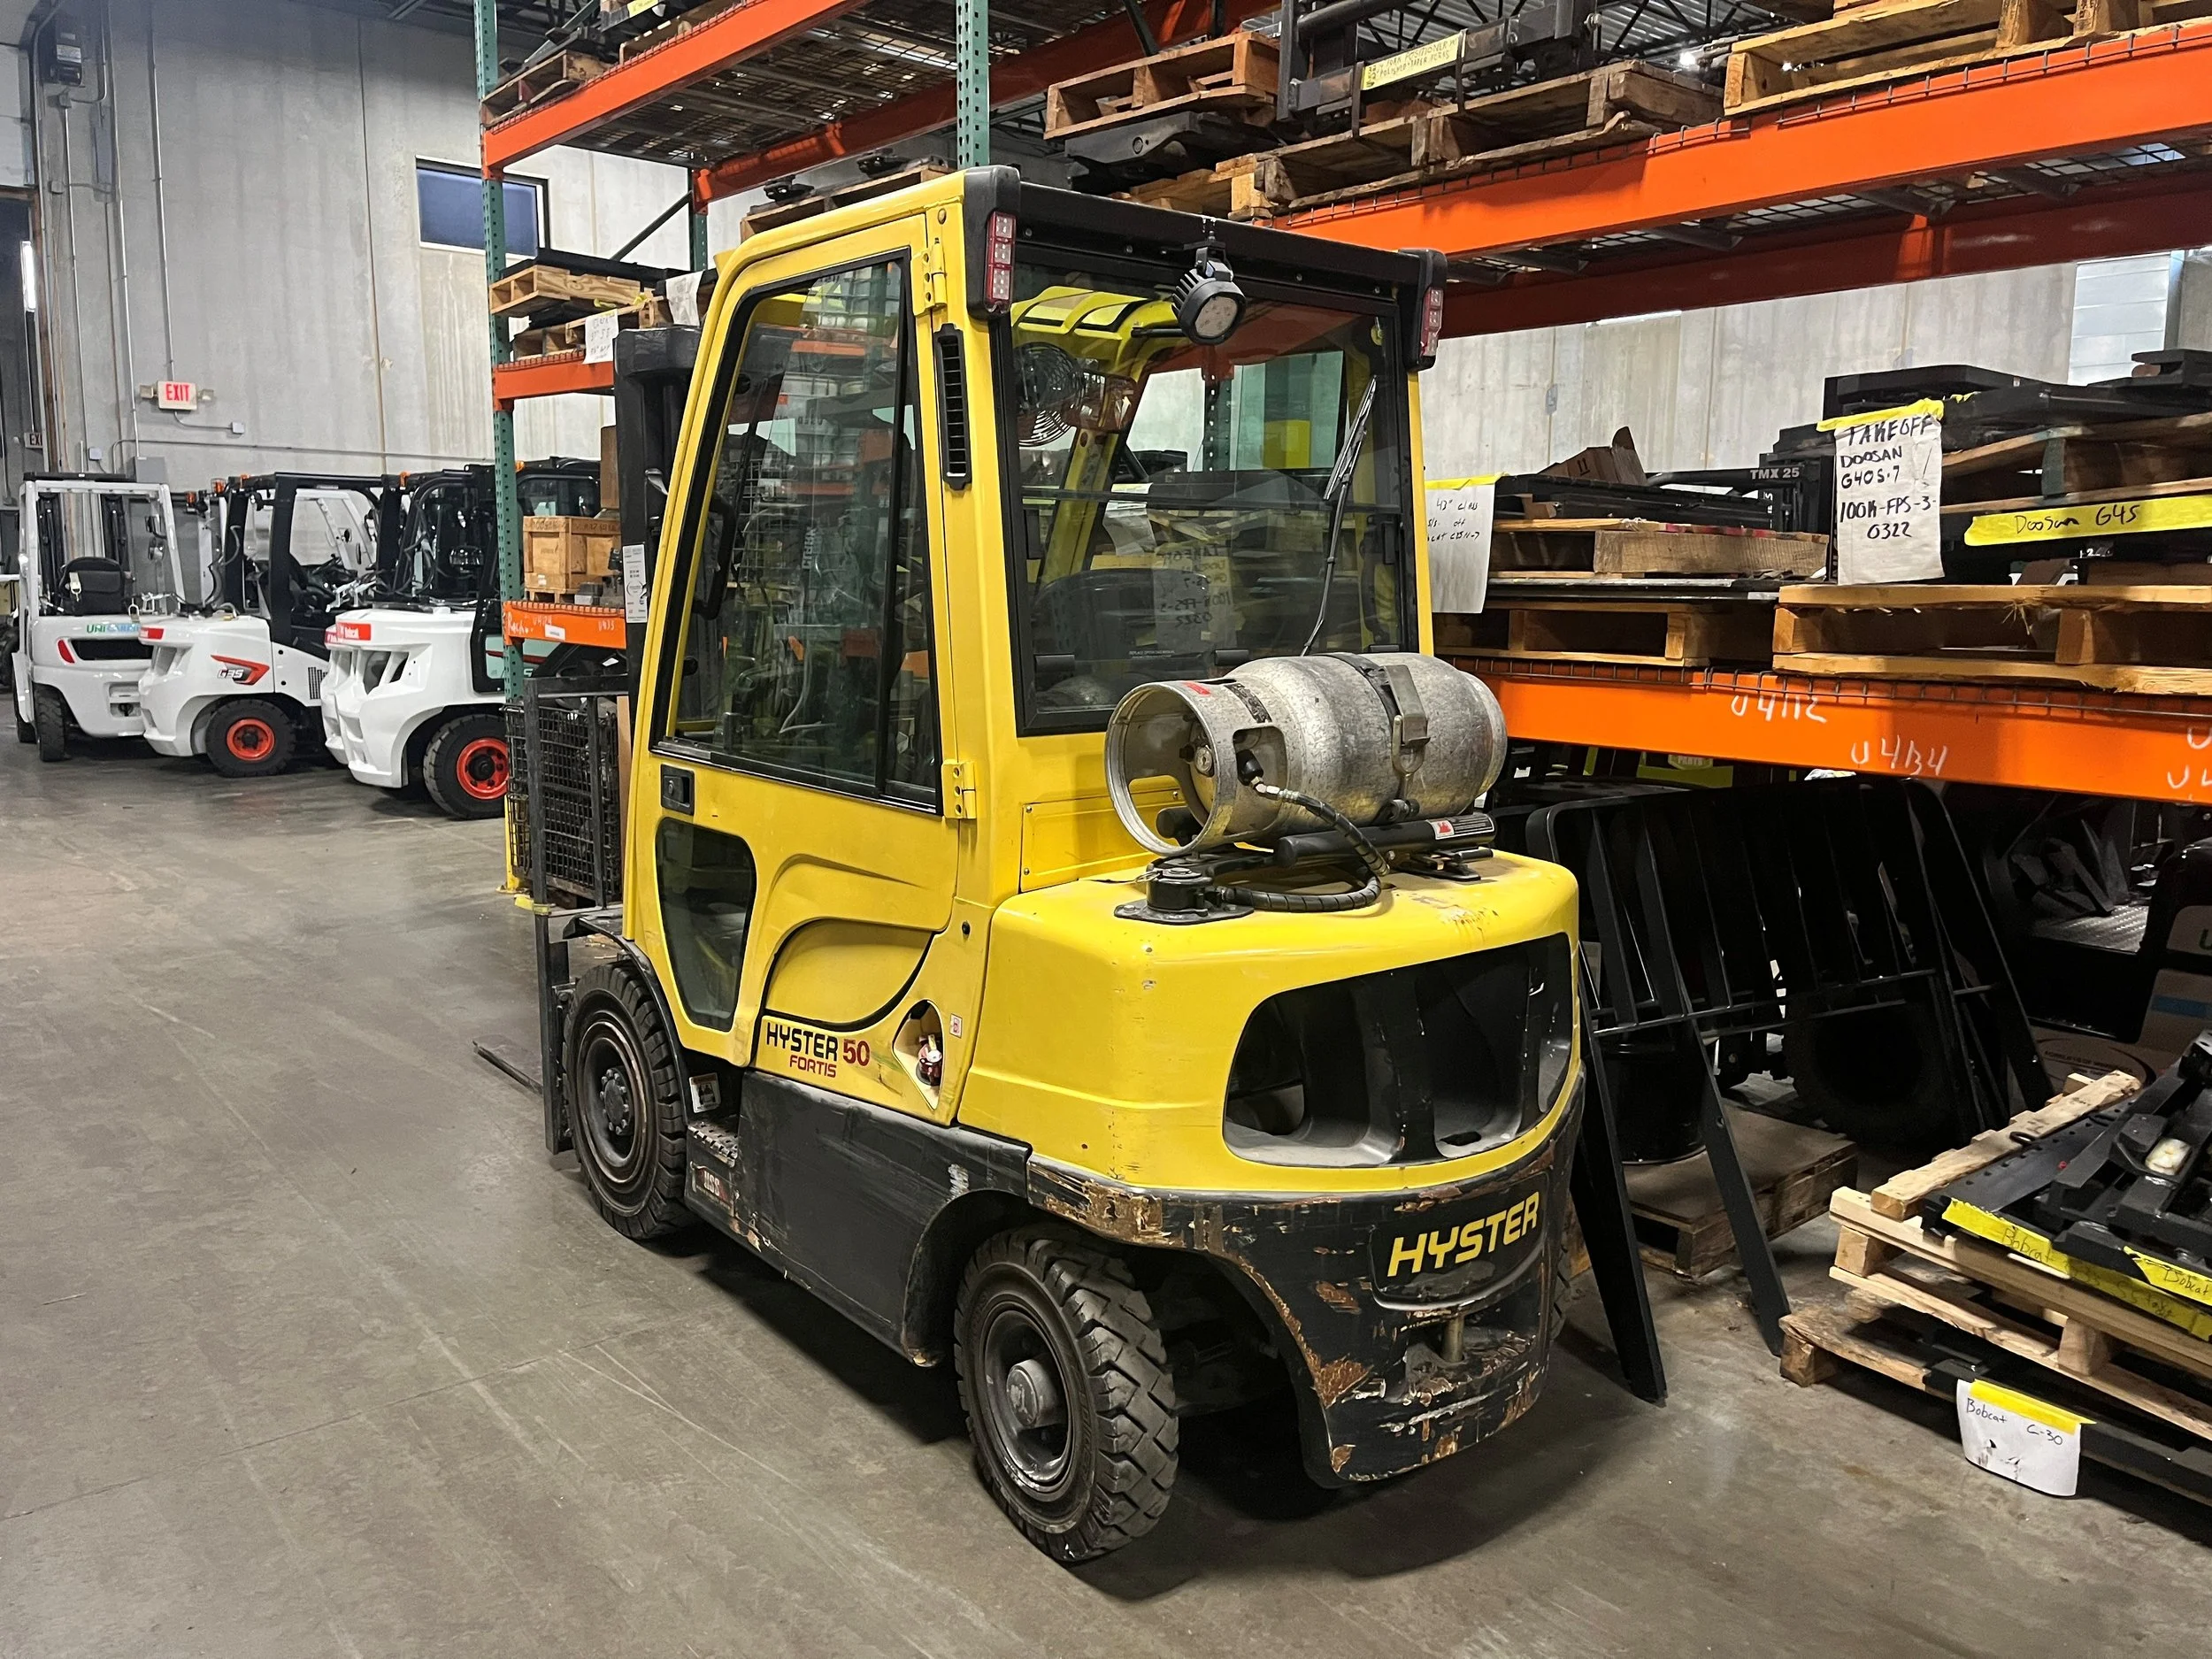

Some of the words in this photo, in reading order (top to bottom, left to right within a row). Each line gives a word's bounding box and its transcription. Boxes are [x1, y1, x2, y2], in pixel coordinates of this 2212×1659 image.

[165, 383, 190, 402] EXIT
[29, 433, 42, 446] EXI
[1842, 412, 1933, 446] TAKEOFF
[1840, 446, 1902, 468] DOOSAN
[1750, 467, 1779, 480] TMX
[1782, 467, 1800, 479] 25
[1866, 521, 1913, 540] 0322
[766, 1022, 839, 1062] HYSTER
[842, 1038, 870, 1067] 50
[789, 1054, 837, 1079] FORTIS
[1386, 1191, 1540, 1278] HYSTER
[2001, 1226, 2054, 1263] Bobcat
[2164, 1268, 2209, 1296] Bobcat
[1966, 1397, 2007, 1424] Bobcat
